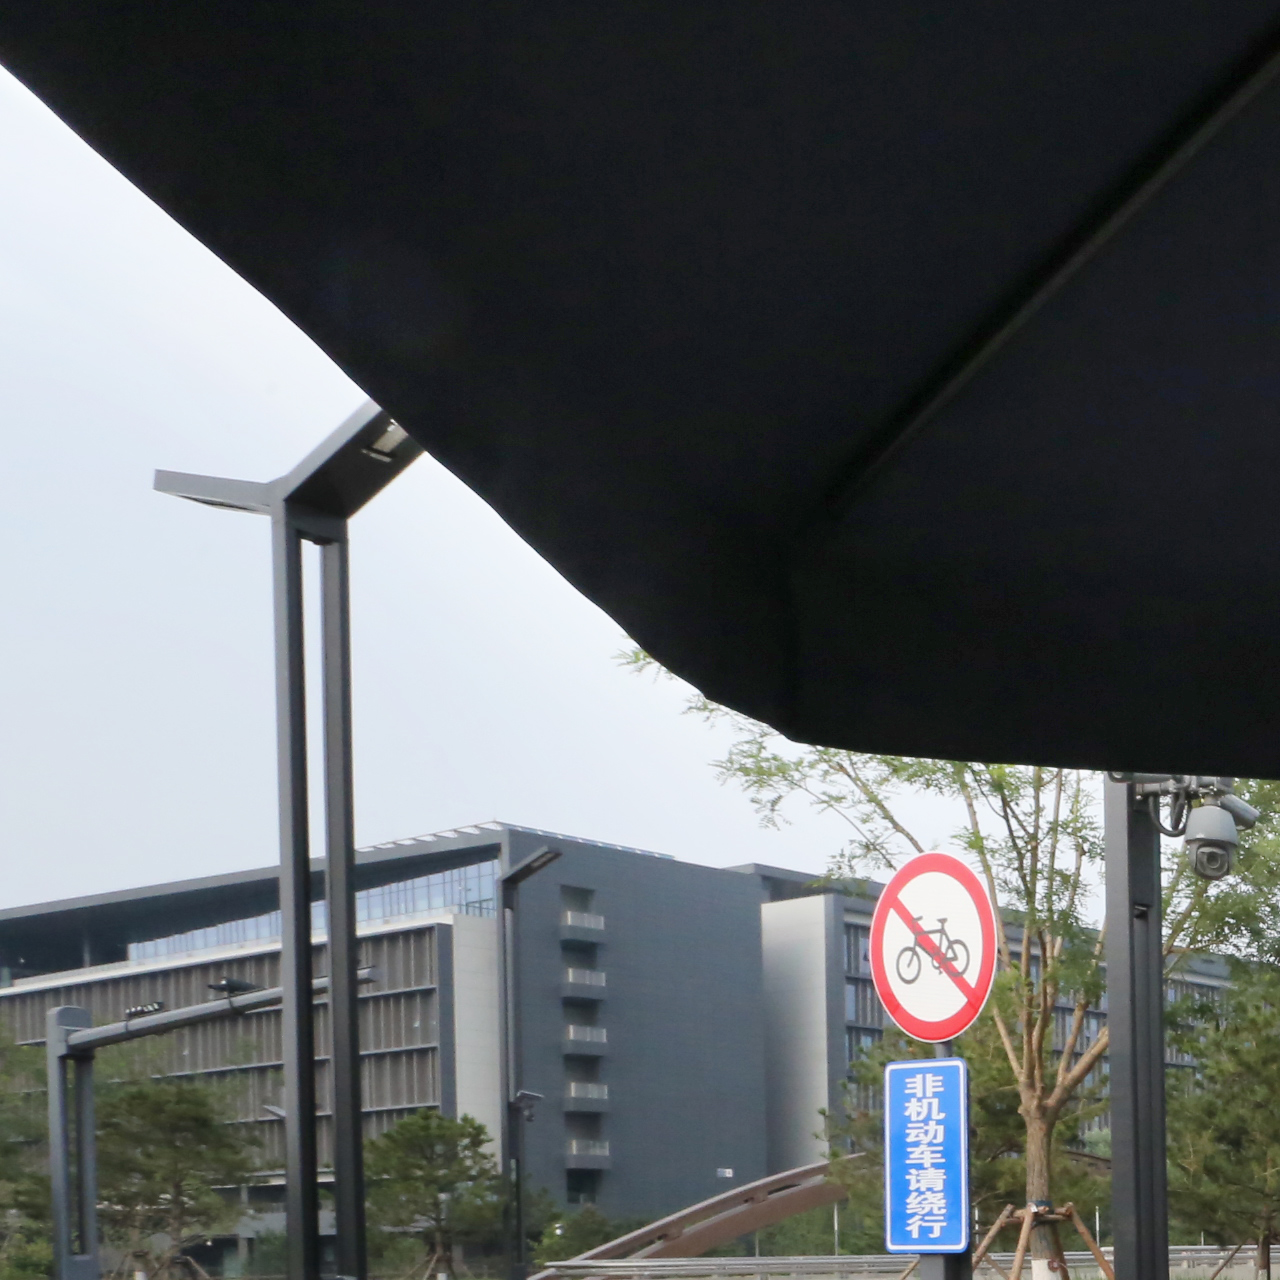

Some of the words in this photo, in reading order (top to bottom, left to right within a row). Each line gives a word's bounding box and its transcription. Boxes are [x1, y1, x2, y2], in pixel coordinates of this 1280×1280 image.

[904, 1073, 947, 1239] 非机动车请绕行
